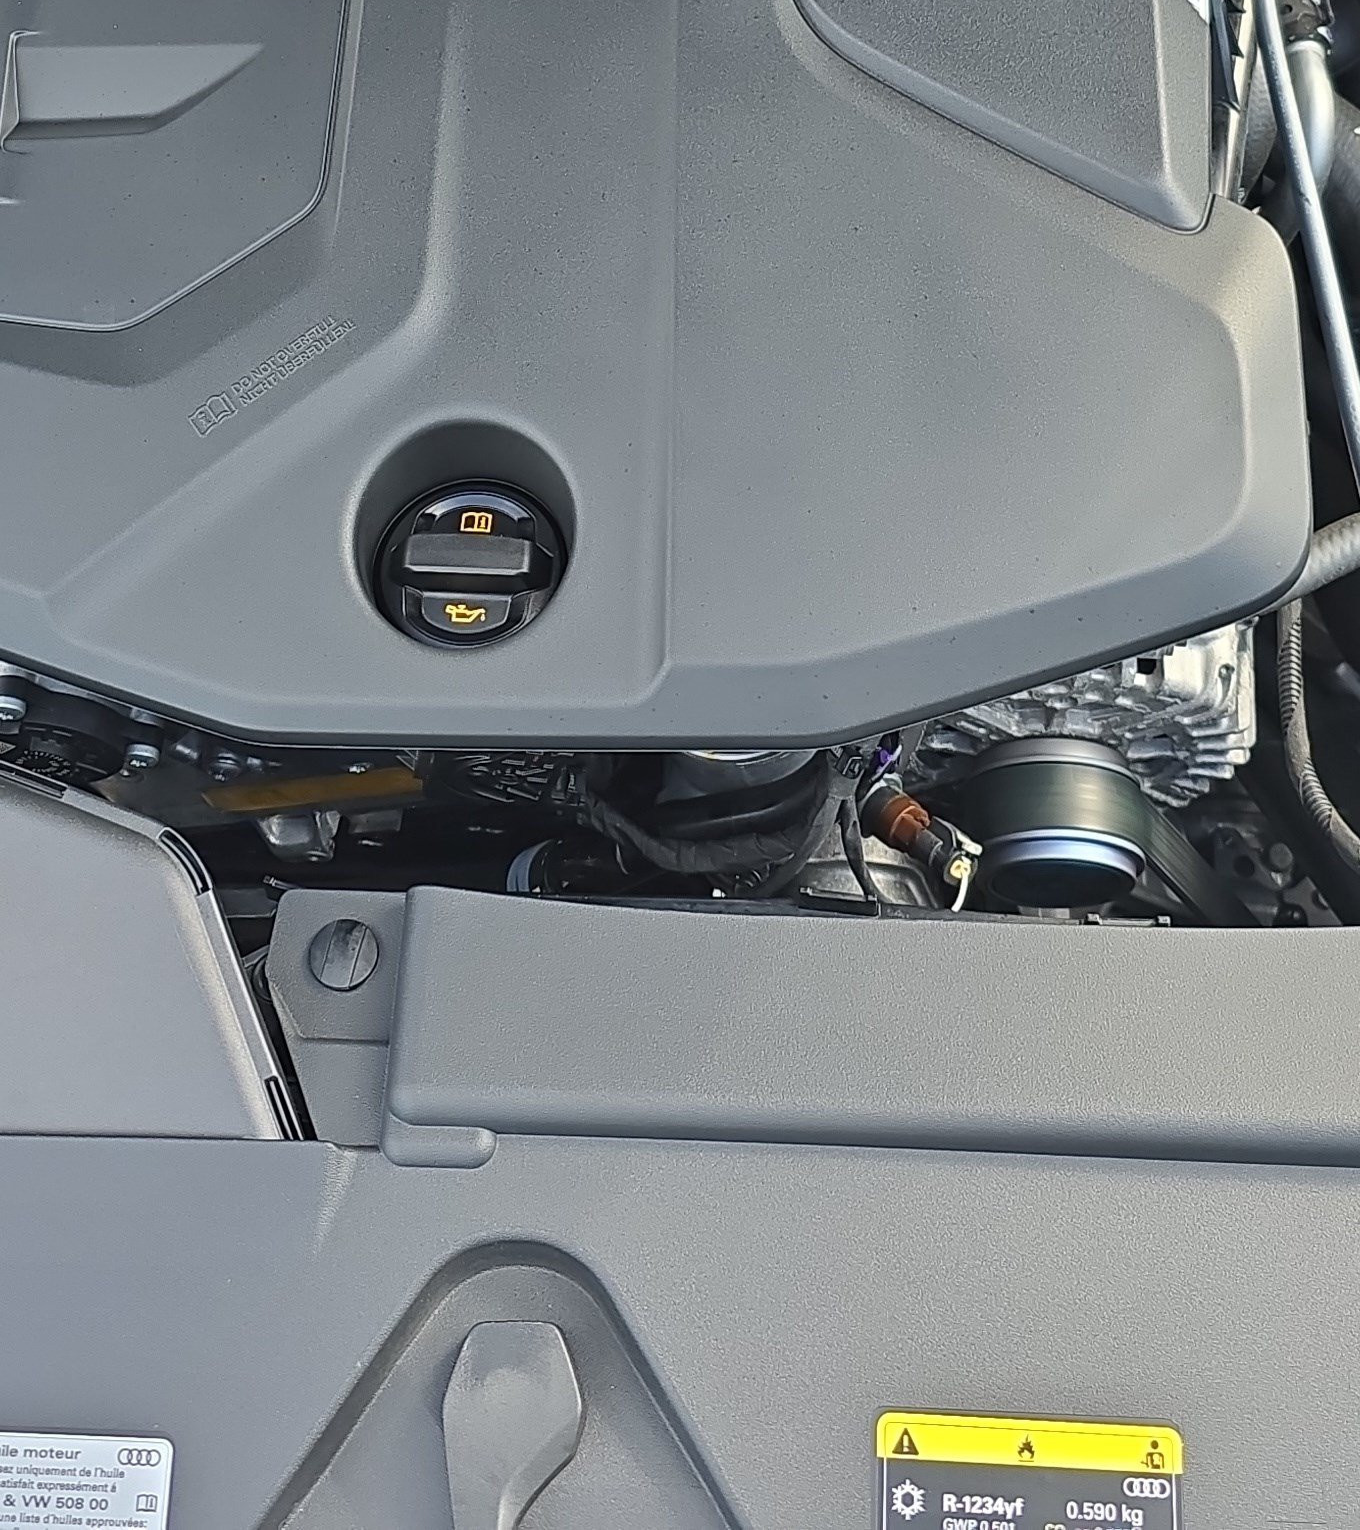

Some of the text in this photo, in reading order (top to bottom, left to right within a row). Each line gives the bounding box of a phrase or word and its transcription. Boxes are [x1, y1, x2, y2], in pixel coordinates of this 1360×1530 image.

[23, 1447, 82, 1460] moteur
[16, 1465, 76, 1478] uniquement
[79, 1467, 91, 1477] de
[37, 1480, 109, 1494] expressément
[3, 1494, 16, 1507] &
[22, 1495, 51, 1508] VW
[56, 1496, 84, 1510] 508
[89, 1498, 109, 1511] 00
[942, 1493, 1144, 1526] R-1234yf 0.590 kg
[19, 1513, 40, 1523] liste
[86, 1515, 148, 1529] approuvées:
